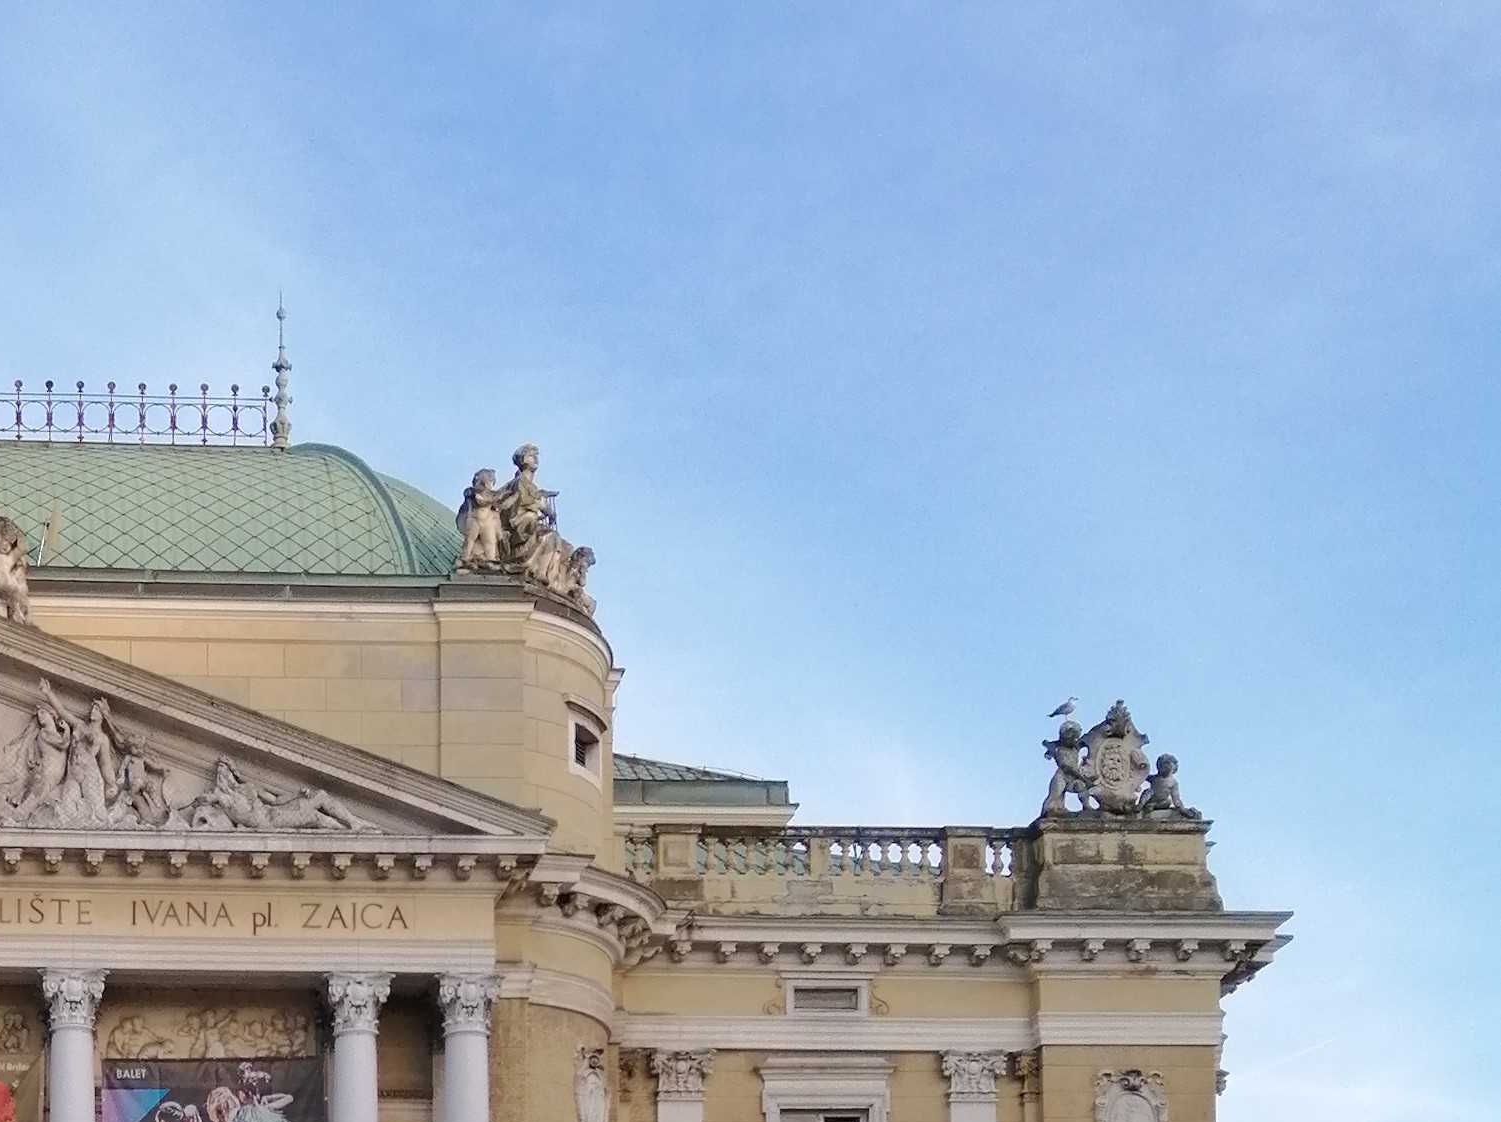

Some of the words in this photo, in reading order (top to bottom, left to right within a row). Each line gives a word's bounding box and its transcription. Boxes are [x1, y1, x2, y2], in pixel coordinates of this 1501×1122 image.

[131, 900, 235, 929] IVANA
[252, 903, 279, 936] pl.
[301, 903, 410, 932] ZAJCA
[116, 1069, 147, 1080] BALET
